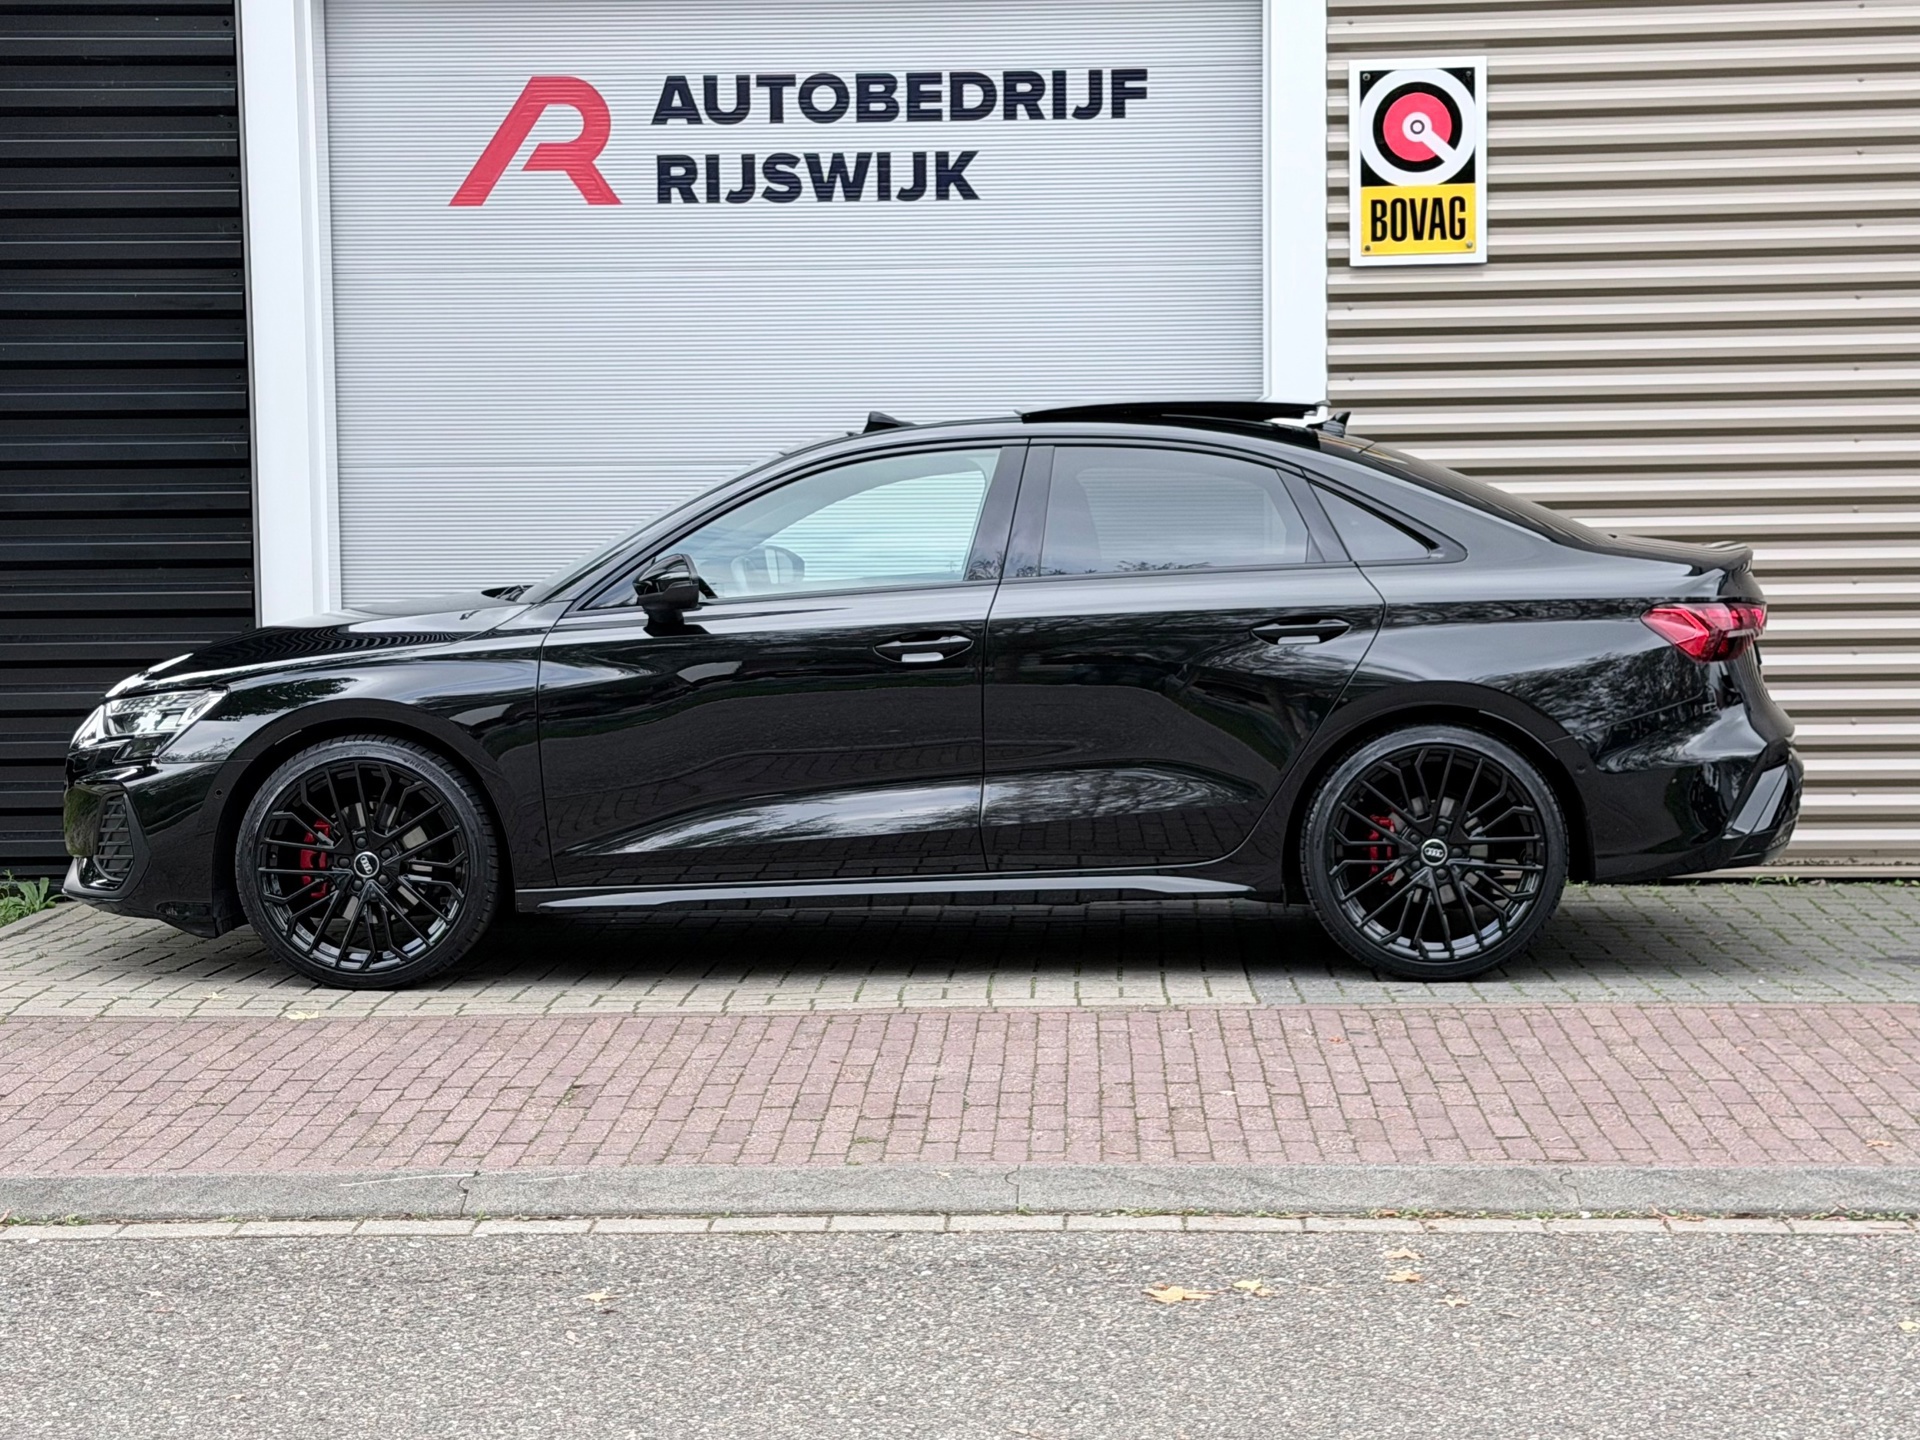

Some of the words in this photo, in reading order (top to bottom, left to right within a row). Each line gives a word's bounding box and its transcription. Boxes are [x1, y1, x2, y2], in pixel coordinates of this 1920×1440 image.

[651, 68, 1148, 126] AUTOBEDRIJF
[656, 150, 980, 204] RIJSWIJK
[1370, 196, 1466, 242] BOVAG
